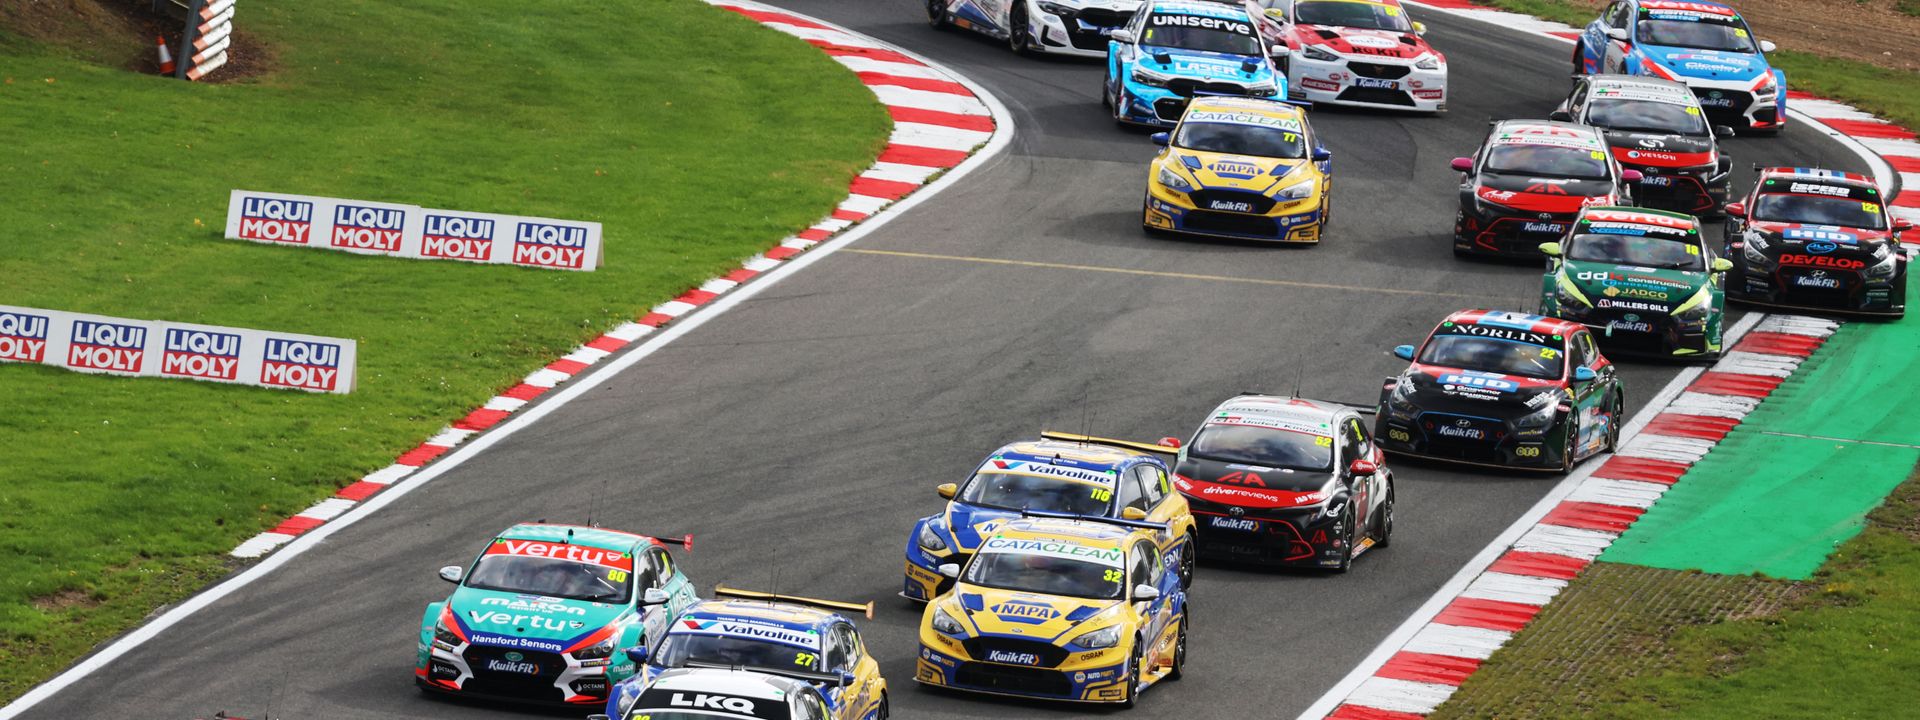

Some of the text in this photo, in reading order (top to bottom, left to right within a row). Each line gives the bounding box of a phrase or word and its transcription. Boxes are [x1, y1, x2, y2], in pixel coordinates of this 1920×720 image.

[1175, 62, 1238, 76] LASER
[1190, 112, 1298, 129] CATACLEAN
[1283, 132, 1296, 142] 77
[1216, 163, 1256, 175] NAPA
[244, 199, 311, 221] LIQUI
[1862, 202, 1879, 214] 123
[337, 206, 403, 229] LIQUI
[242, 219, 309, 241] MOLY
[427, 216, 493, 239] LIQUI
[519, 224, 585, 247] LIQUI
[1791, 229, 1851, 241] HID
[334, 228, 401, 249] MOLY
[424, 237, 491, 259] MOLY
[516, 245, 584, 266] MOLY
[1685, 244, 1699, 256] 18
[1778, 253, 1865, 269] DEVELOP
[1627, 277, 1692, 290] construction
[1622, 288, 1668, 299] JADCO
[1612, 301, 1669, 312] MILLERS OILS
[0, 314, 46, 338] QUI
[1452, 324, 1546, 343] NORLIN
[74, 322, 145, 348] LIQUI
[168, 330, 239, 355] LIQUI
[0, 336, 44, 360] OLY
[267, 340, 338, 366] LIQUI
[1539, 347, 1555, 359] 22
[70, 345, 143, 370] MOLY
[165, 353, 238, 378] MOLY
[264, 363, 337, 388] MOLY
[1447, 375, 1511, 389] HID
[1315, 436, 1332, 448] 52
[1028, 464, 1111, 483] Valvoline
[1090, 488, 1111, 503] 116
[921, 550, 937, 564] OSRAM
[988, 538, 1120, 562] CATACLEAN
[607, 570, 626, 583] 80
[1103, 569, 1122, 583] 32
[1003, 603, 1049, 618] NAPA
[471, 634, 562, 651] Hansford Sensors
[722, 624, 813, 644] Valvoline
[936, 633, 953, 647] OSRAM
[795, 652, 815, 667] 27
[1080, 650, 1104, 661] OSRAM
[437, 665, 457, 674] OCTANE
[670, 692, 754, 715] LKQ
